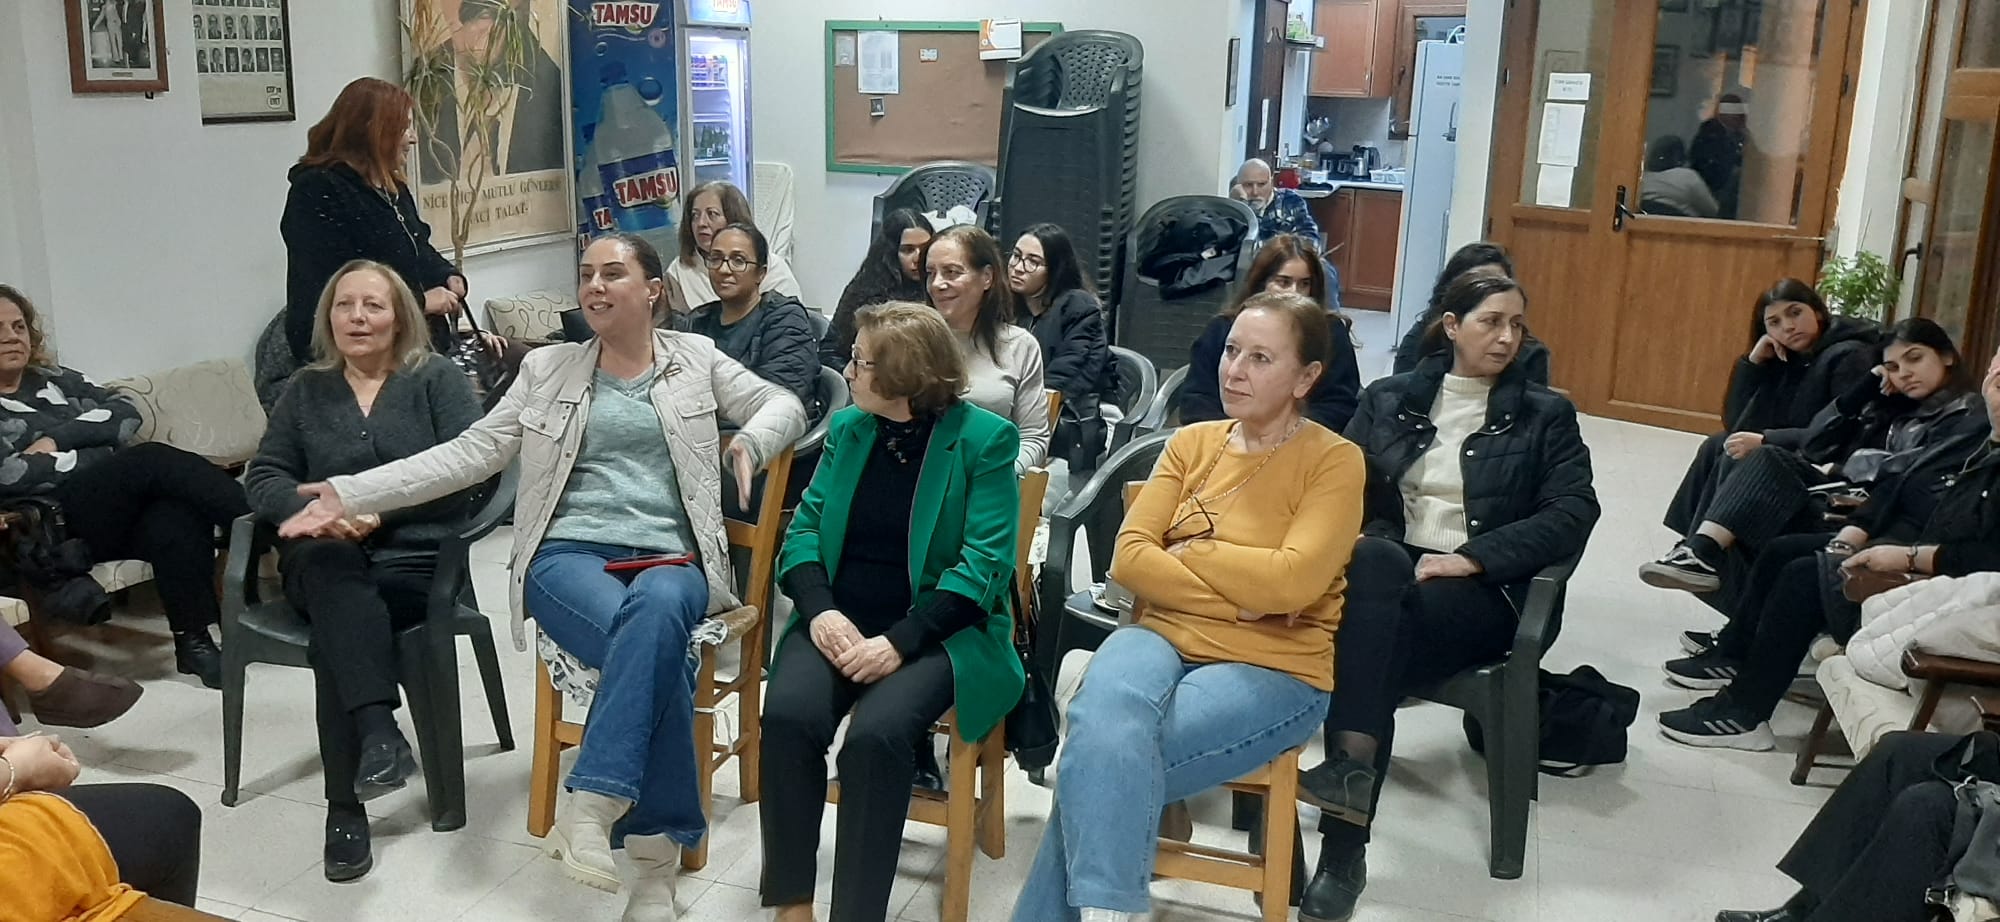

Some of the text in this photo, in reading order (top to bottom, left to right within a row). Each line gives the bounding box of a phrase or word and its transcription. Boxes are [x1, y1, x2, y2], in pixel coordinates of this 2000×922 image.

[594, 4, 653, 25] TAMSU
[482, 184, 515, 200] MUTLU
[615, 170, 677, 205] TAMSU
